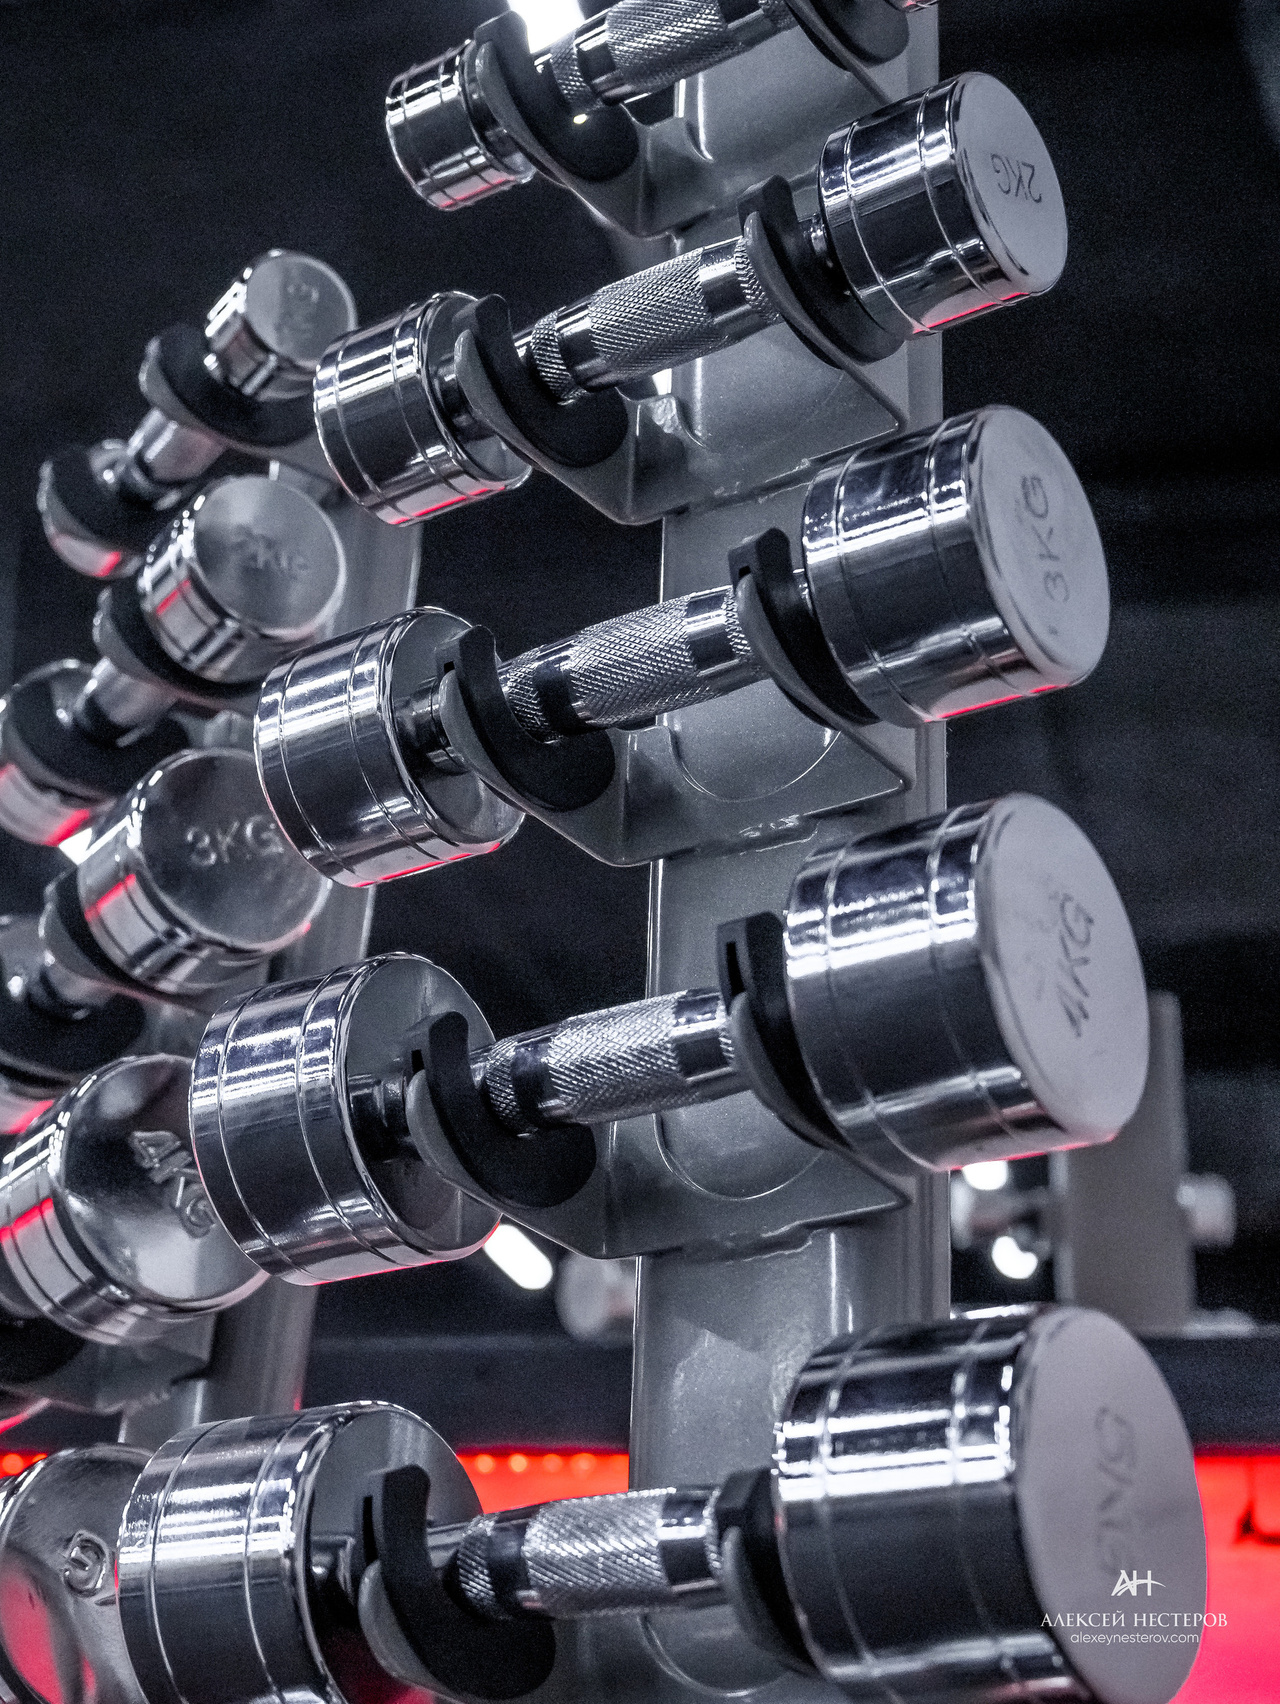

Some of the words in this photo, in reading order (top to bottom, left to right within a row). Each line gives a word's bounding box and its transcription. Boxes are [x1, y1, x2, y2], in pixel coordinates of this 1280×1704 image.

[989, 153, 1043, 204] 2KG
[1022, 474, 1070, 602] 3KG
[186, 814, 284, 868] 3KG
[1056, 892, 1095, 1038] 4KG
